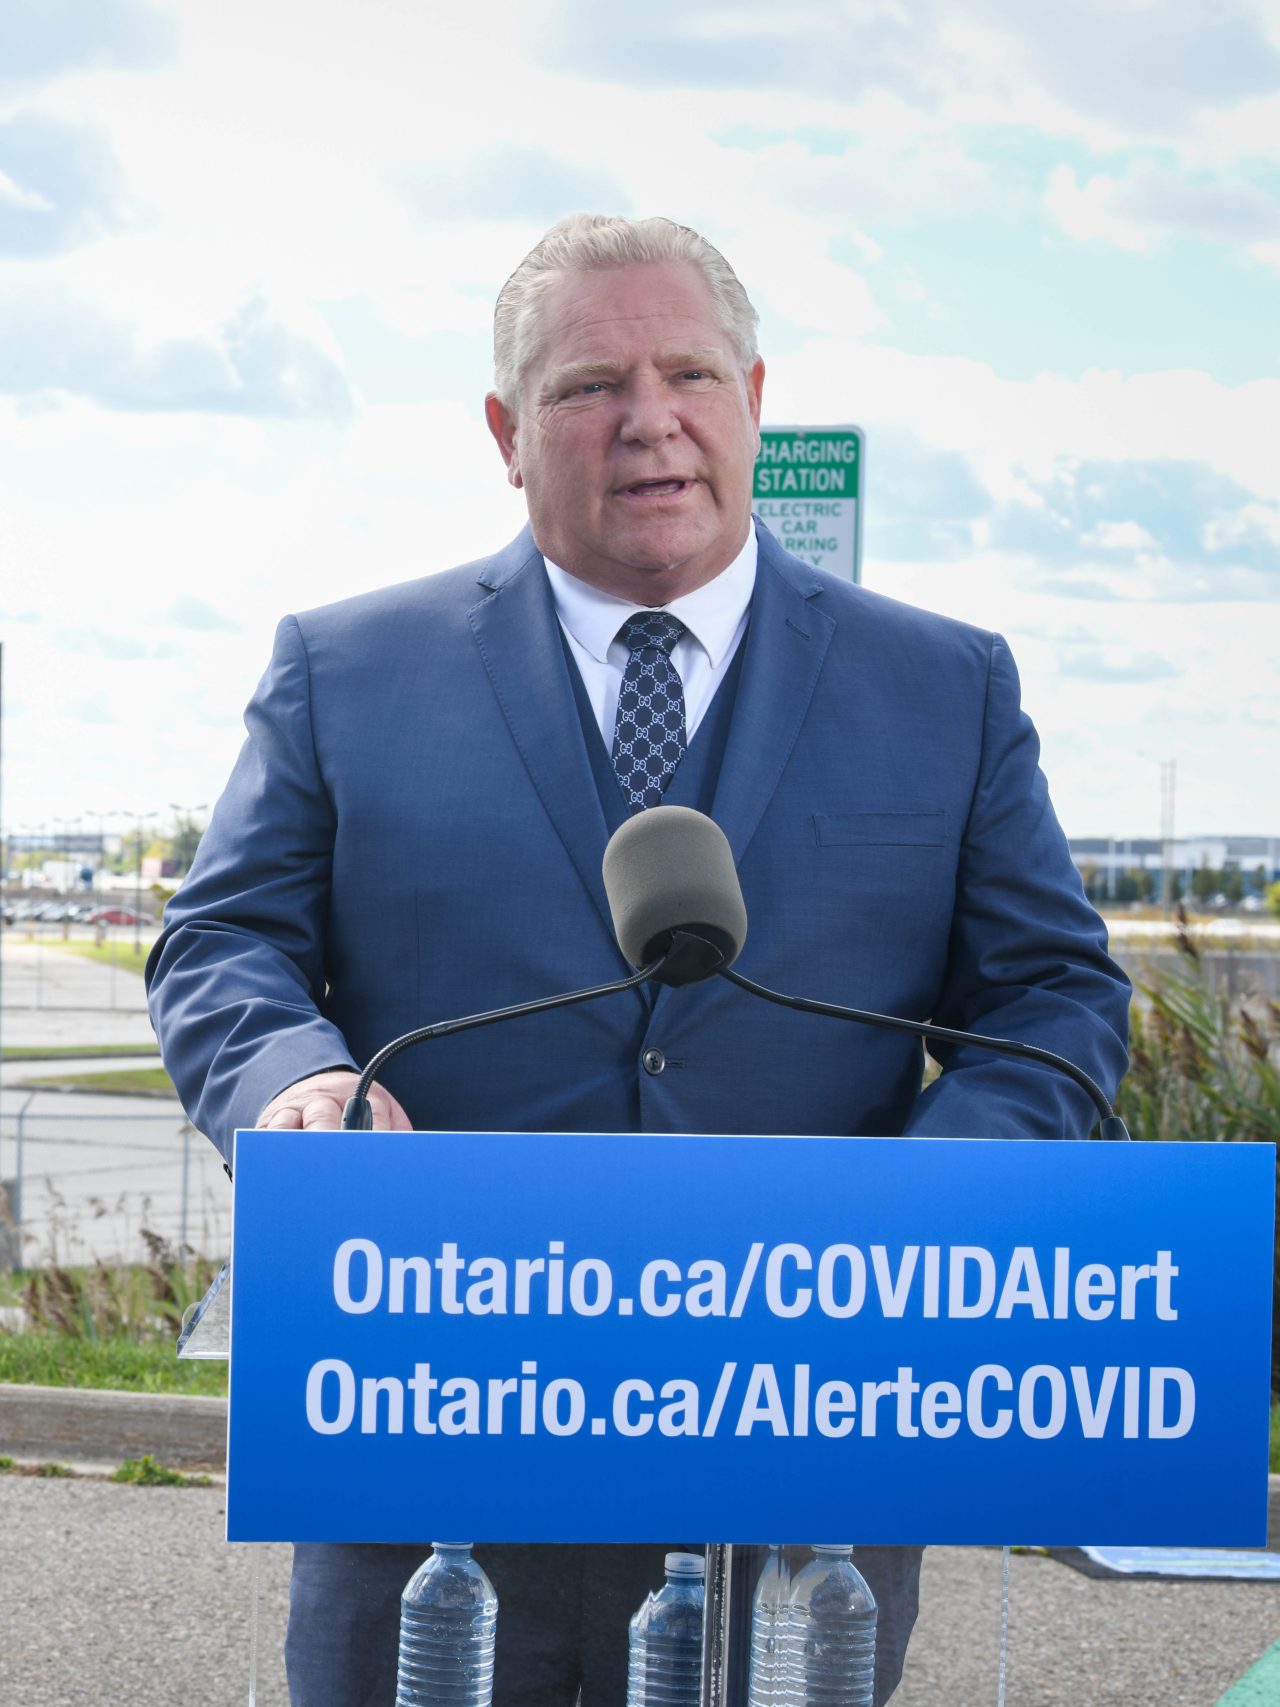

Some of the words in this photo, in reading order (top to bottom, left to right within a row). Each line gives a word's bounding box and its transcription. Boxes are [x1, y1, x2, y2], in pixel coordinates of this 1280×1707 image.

[757, 468, 846, 491] STATION
[758, 503, 842, 517] ELECTRIC
[781, 520, 818, 534] CAR
[778, 537, 838, 551] RKING
[333, 1238, 1179, 1321] Ontario.ca/COVIDAlert
[305, 1358, 1196, 1440] Ontario.ca/AlerteCOVID
